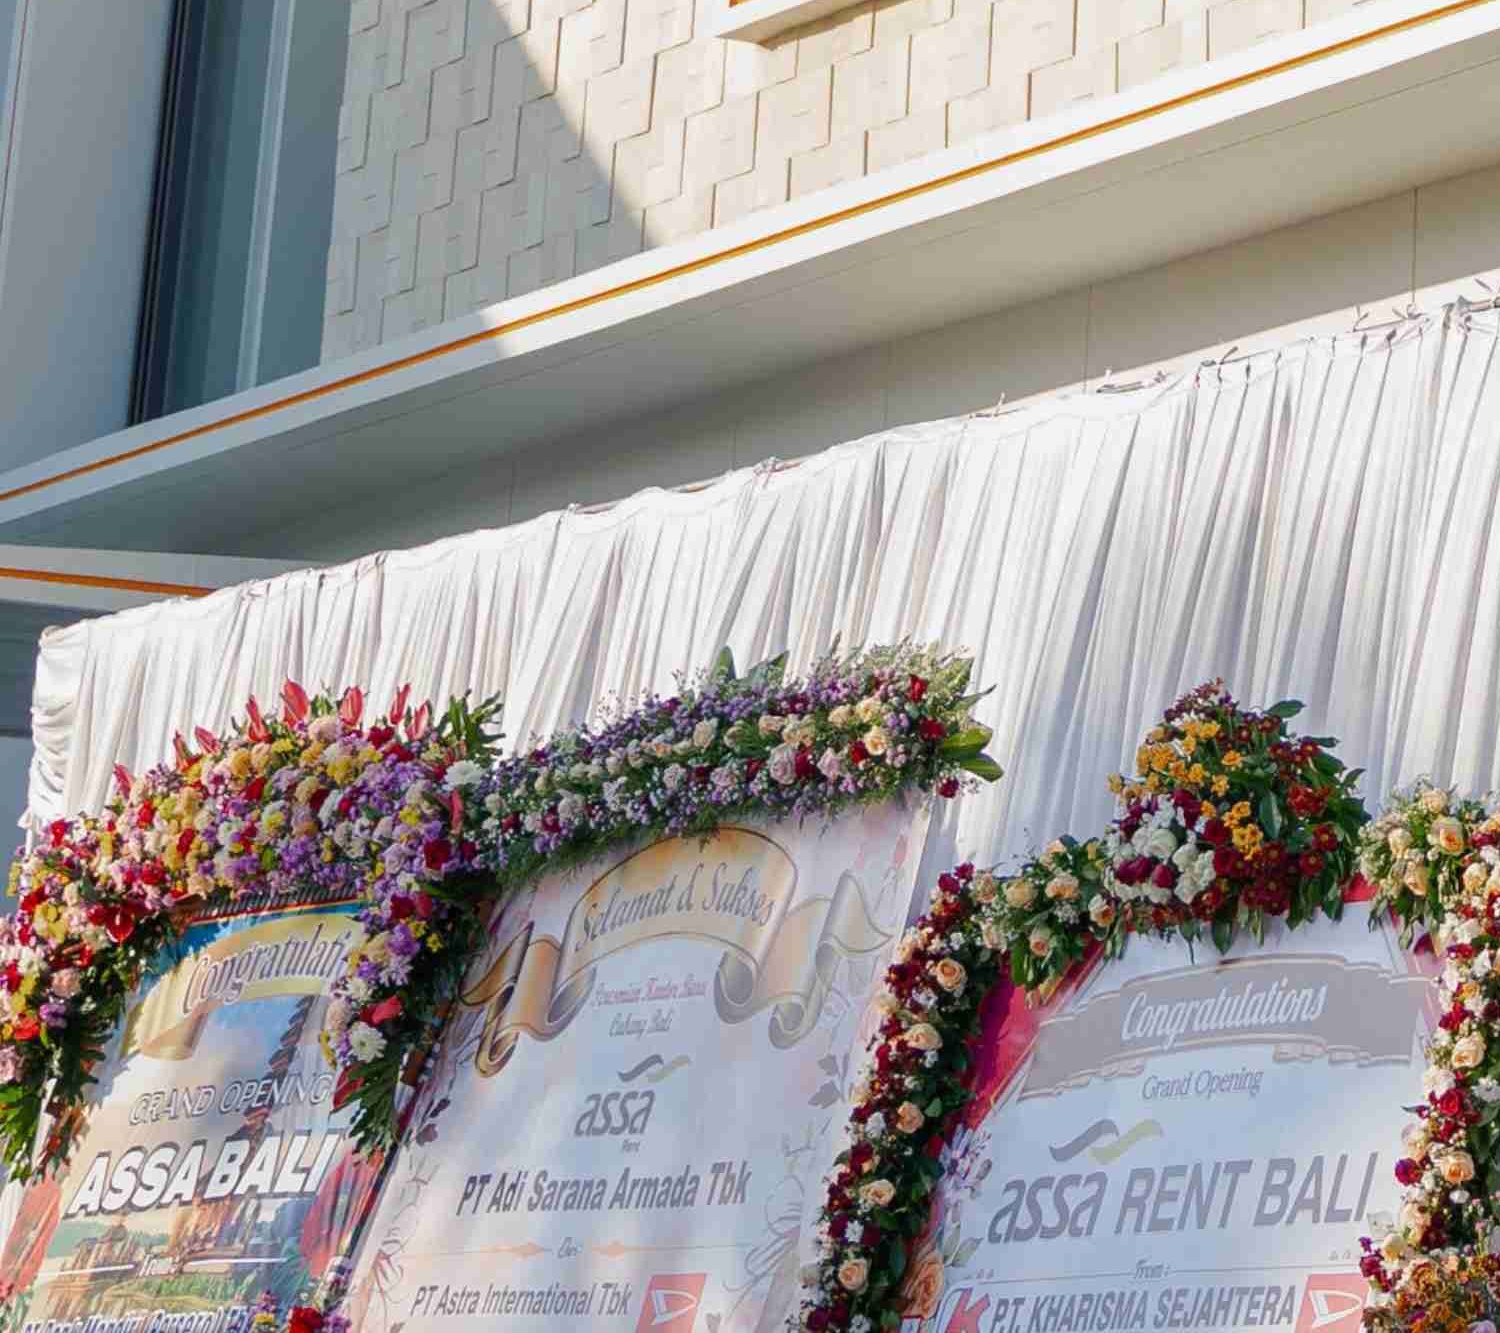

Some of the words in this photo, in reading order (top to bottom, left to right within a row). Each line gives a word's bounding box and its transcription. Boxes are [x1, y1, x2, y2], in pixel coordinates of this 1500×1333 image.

[575, 874, 678, 952] Selamat
[702, 861, 776, 927] Sukses
[1121, 976, 1328, 1051] Congratulations
[130, 1084, 217, 1126] GRAND
[219, 1071, 337, 1117] OPENING
[1142, 1072, 1192, 1101] Grand
[1193, 1067, 1265, 1102] Opening
[574, 1090, 656, 1137] assa
[62, 1140, 208, 1220] ASSA
[203, 1129, 346, 1200] BALI
[456, 1174, 493, 1217] PT
[486, 1170, 529, 1214] Adi
[527, 1170, 608, 1213] Sarana
[608, 1165, 702, 1211] Armada
[705, 1160, 754, 1206] Tbk
[987, 1171, 1108, 1245] assa
[1114, 1159, 1253, 1235] RENT
[1253, 1151, 1379, 1227] BALI
[411, 1284, 439, 1317] PT
[436, 1282, 482, 1316] Astra
[480, 1281, 594, 1316] International
[597, 1281, 632, 1316] Tbk
[990, 1294, 1022, 1333] P.T.
[1029, 1287, 1150, 1333] KHARISMA
[1153, 1283, 1297, 1329] SEJAHTERA
